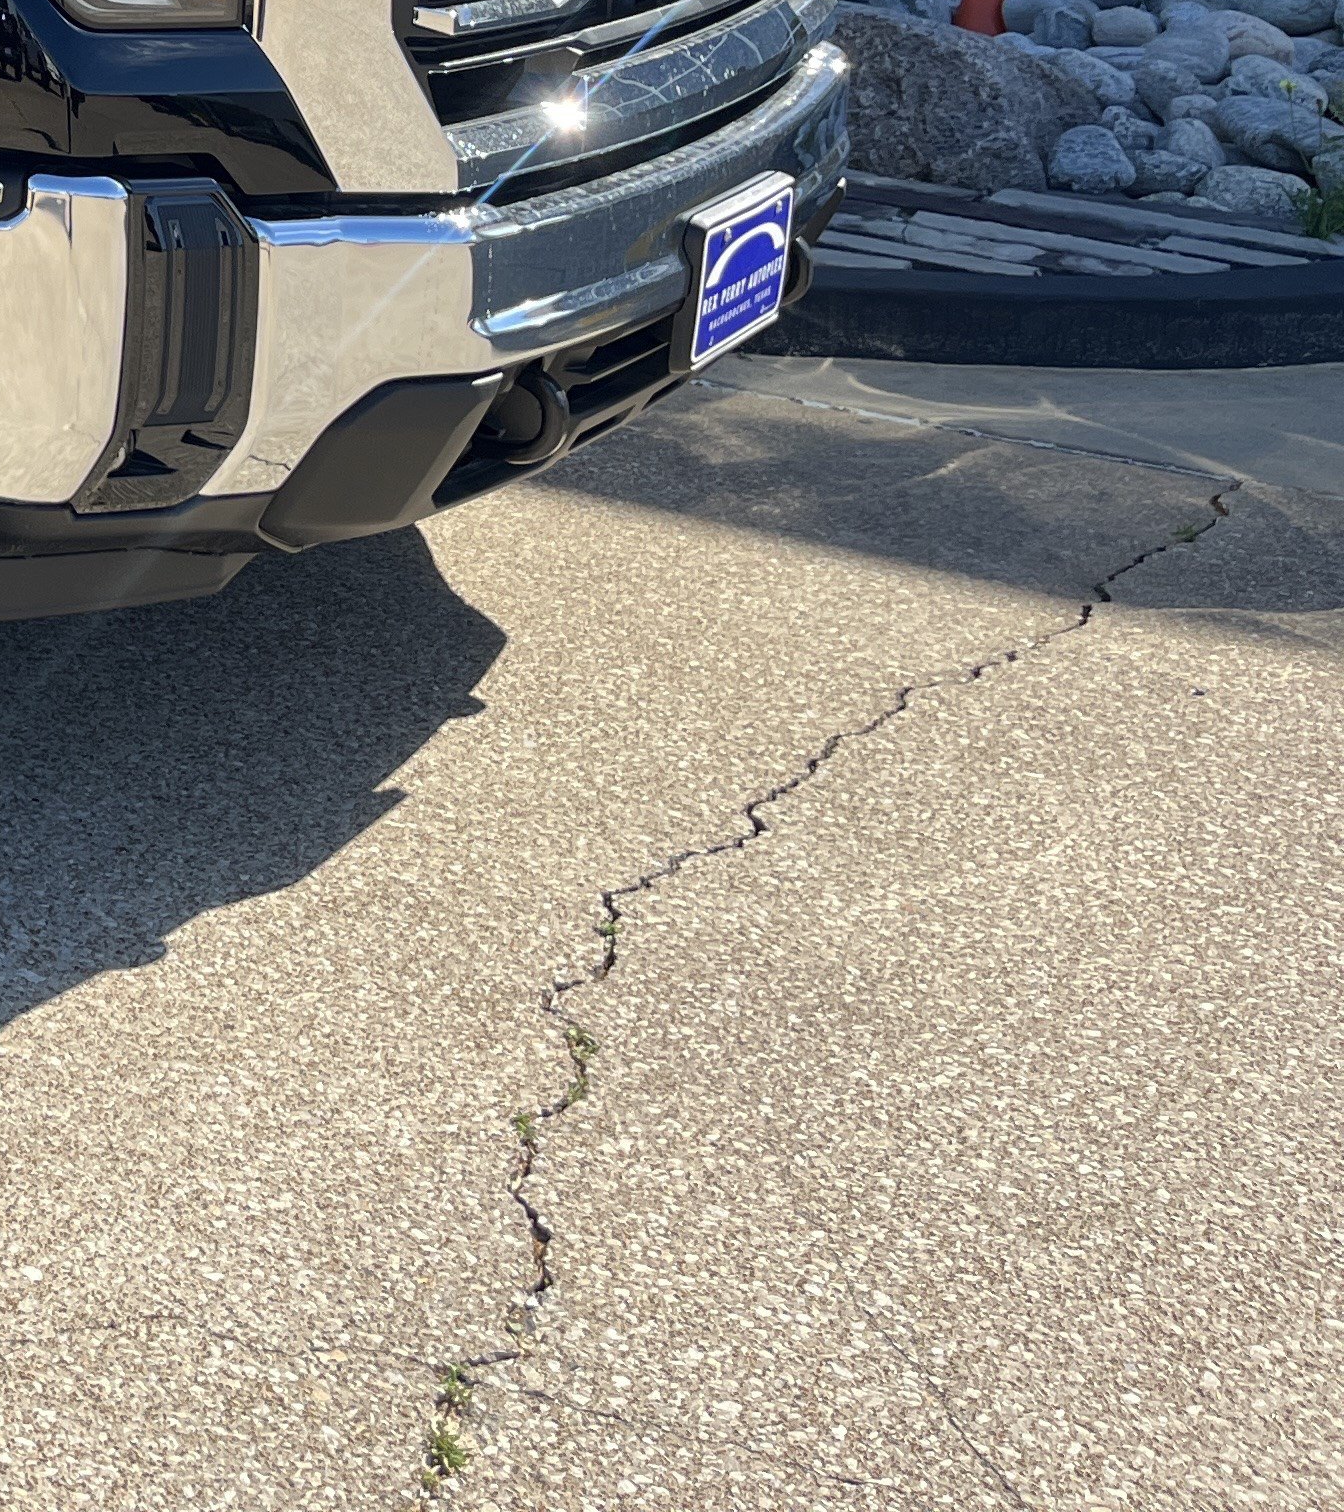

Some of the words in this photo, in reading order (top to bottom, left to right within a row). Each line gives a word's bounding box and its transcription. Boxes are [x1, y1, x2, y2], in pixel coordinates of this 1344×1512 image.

[701, 291, 718, 317] REX
[720, 277, 746, 307] PERRY
[747, 254, 784, 291] AUTOPLEX
[754, 285, 772, 304] TEXAS
